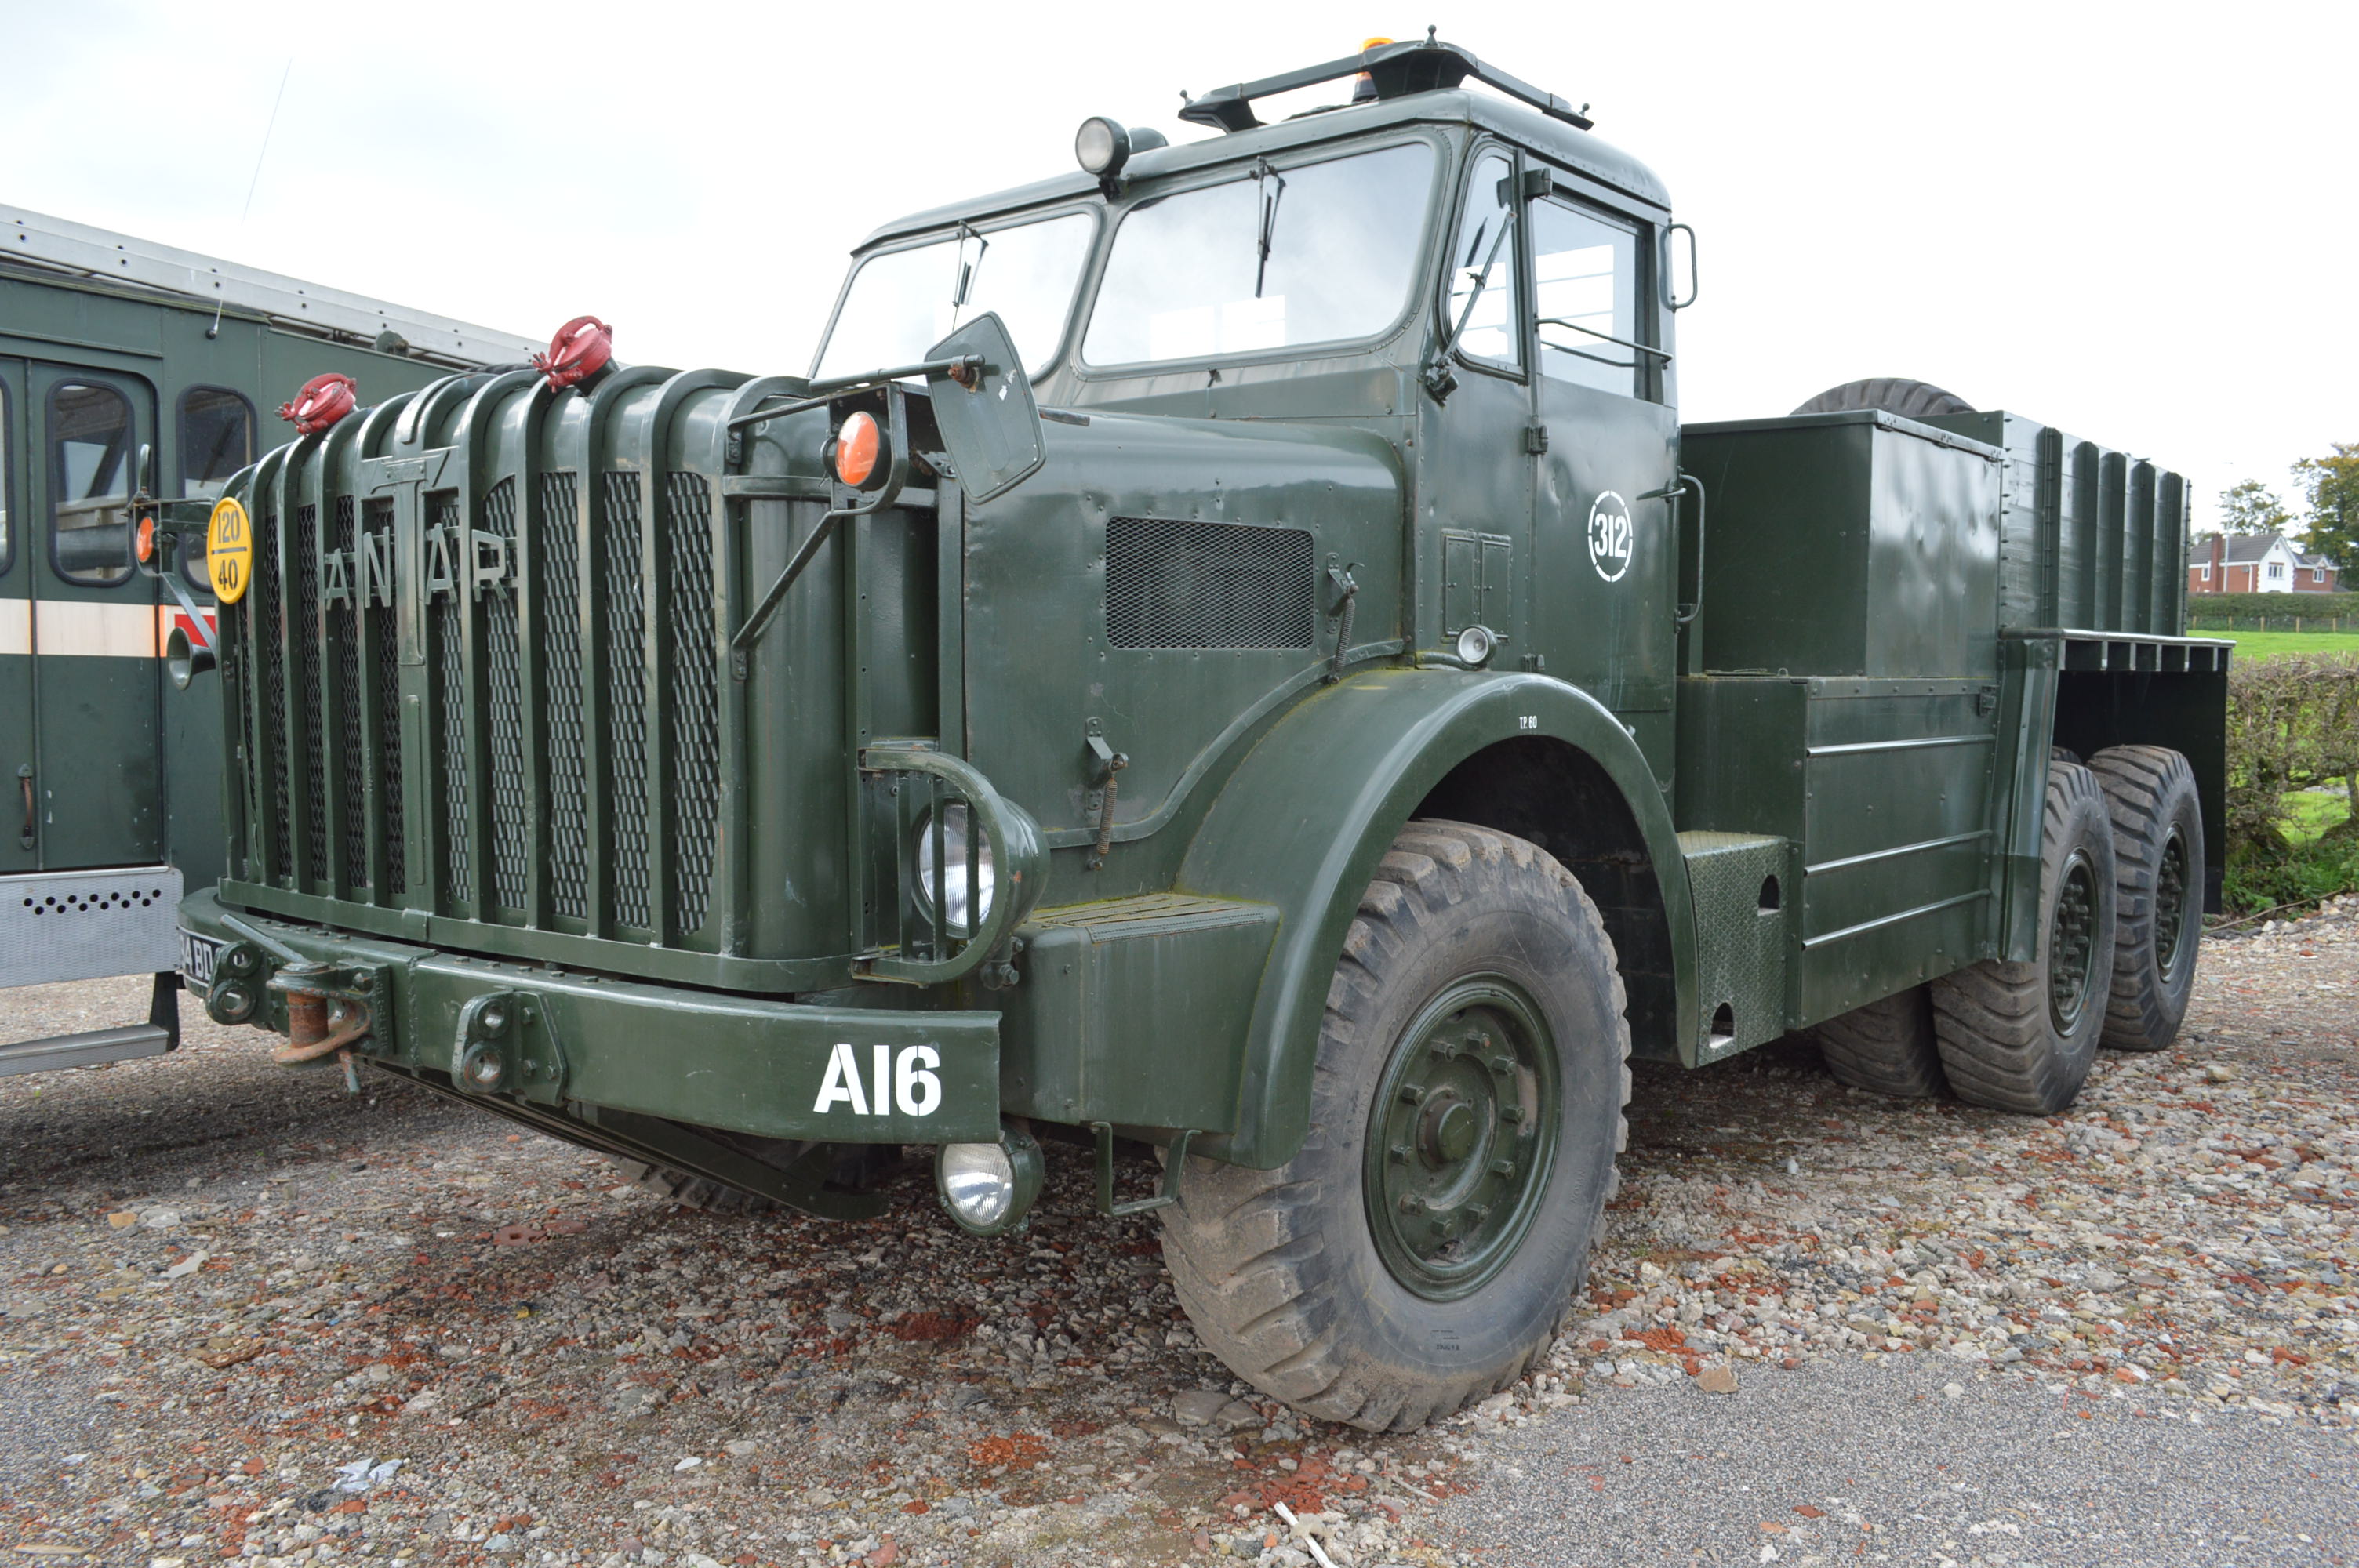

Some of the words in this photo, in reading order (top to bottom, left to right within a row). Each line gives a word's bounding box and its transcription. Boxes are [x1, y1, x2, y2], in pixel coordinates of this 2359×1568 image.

[217, 509, 240, 543] 120
[1594, 513, 1627, 558] 312
[218, 558, 238, 590] 40
[1528, 715, 1538, 729] 60
[812, 1044, 941, 1116] A16
